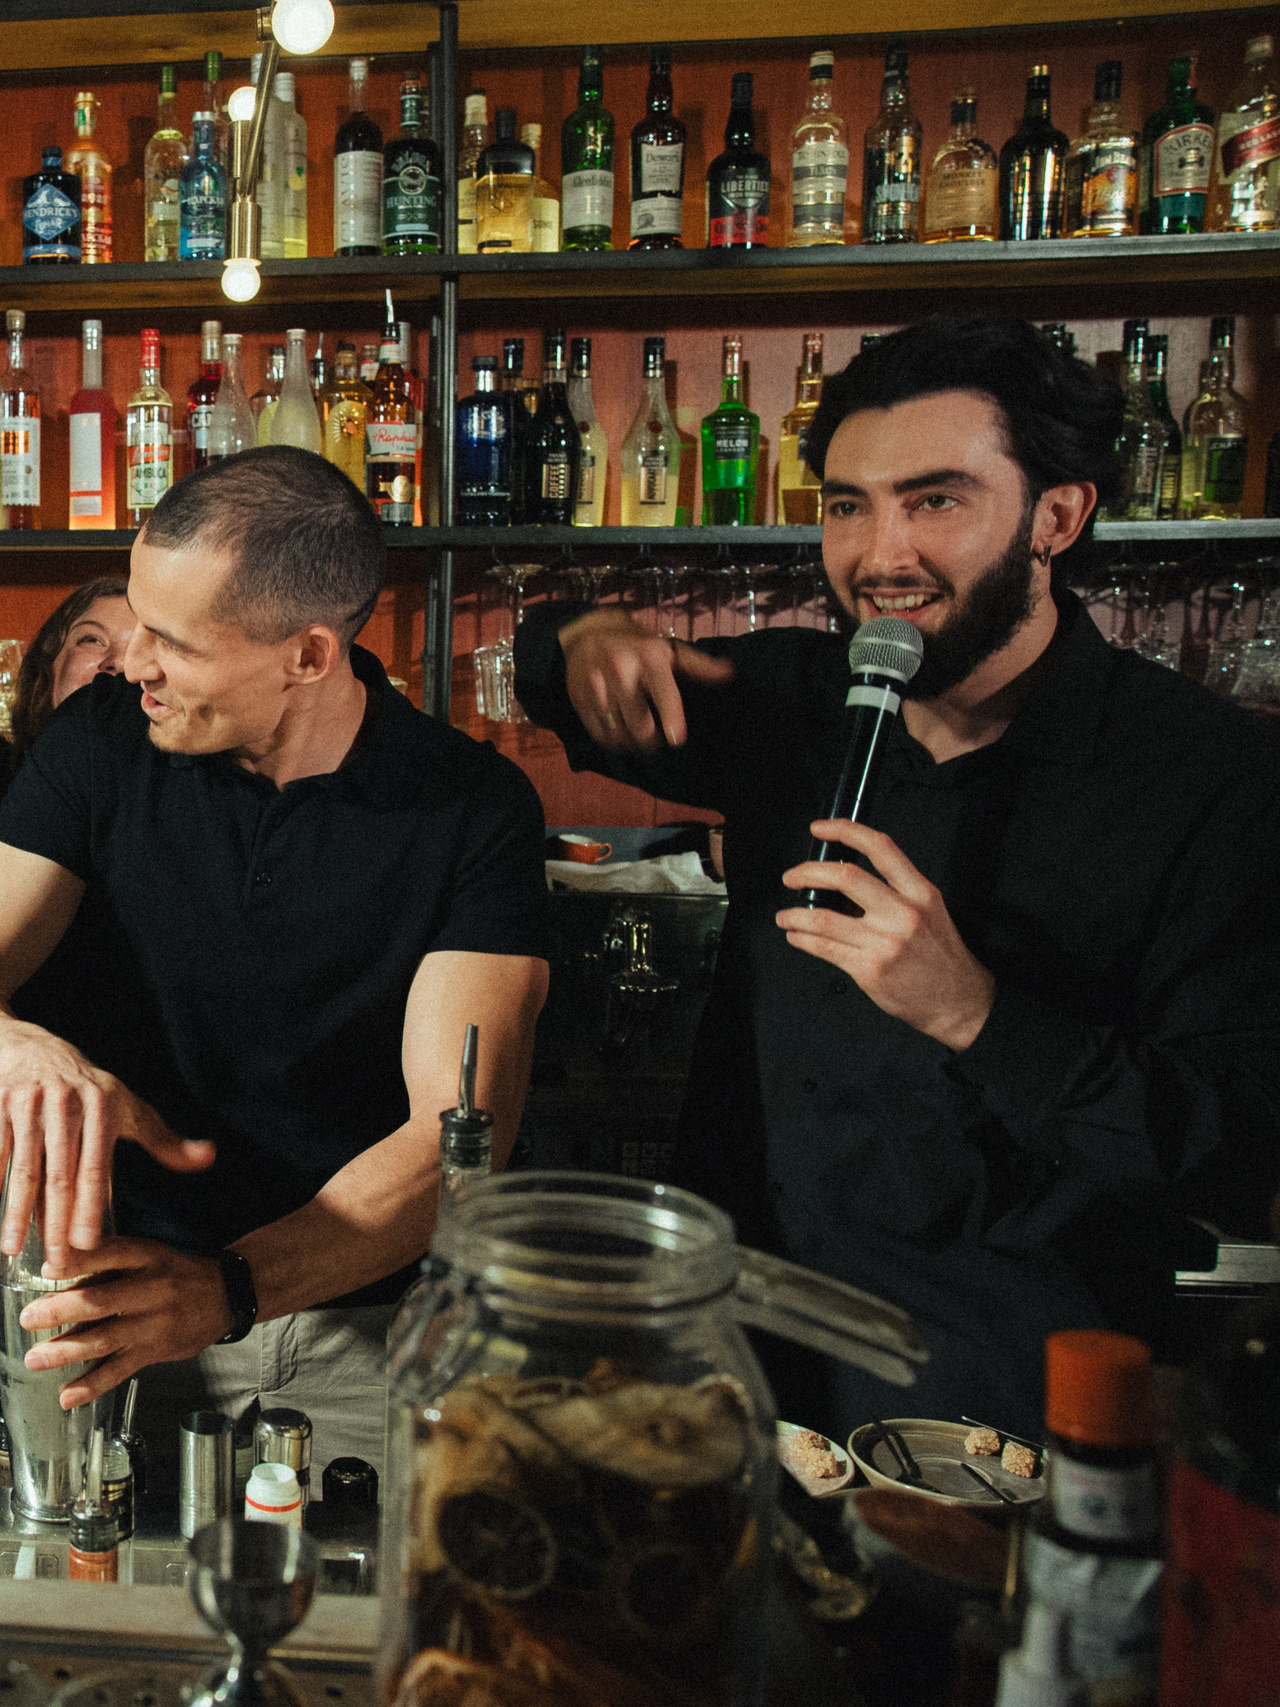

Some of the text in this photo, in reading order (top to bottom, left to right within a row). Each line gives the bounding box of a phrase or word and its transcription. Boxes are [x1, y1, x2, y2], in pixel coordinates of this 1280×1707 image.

[23, 207, 78, 219] HENDRICK'S
[716, 439, 748, 448] MELON
[549, 464, 560, 499] COFFEE
